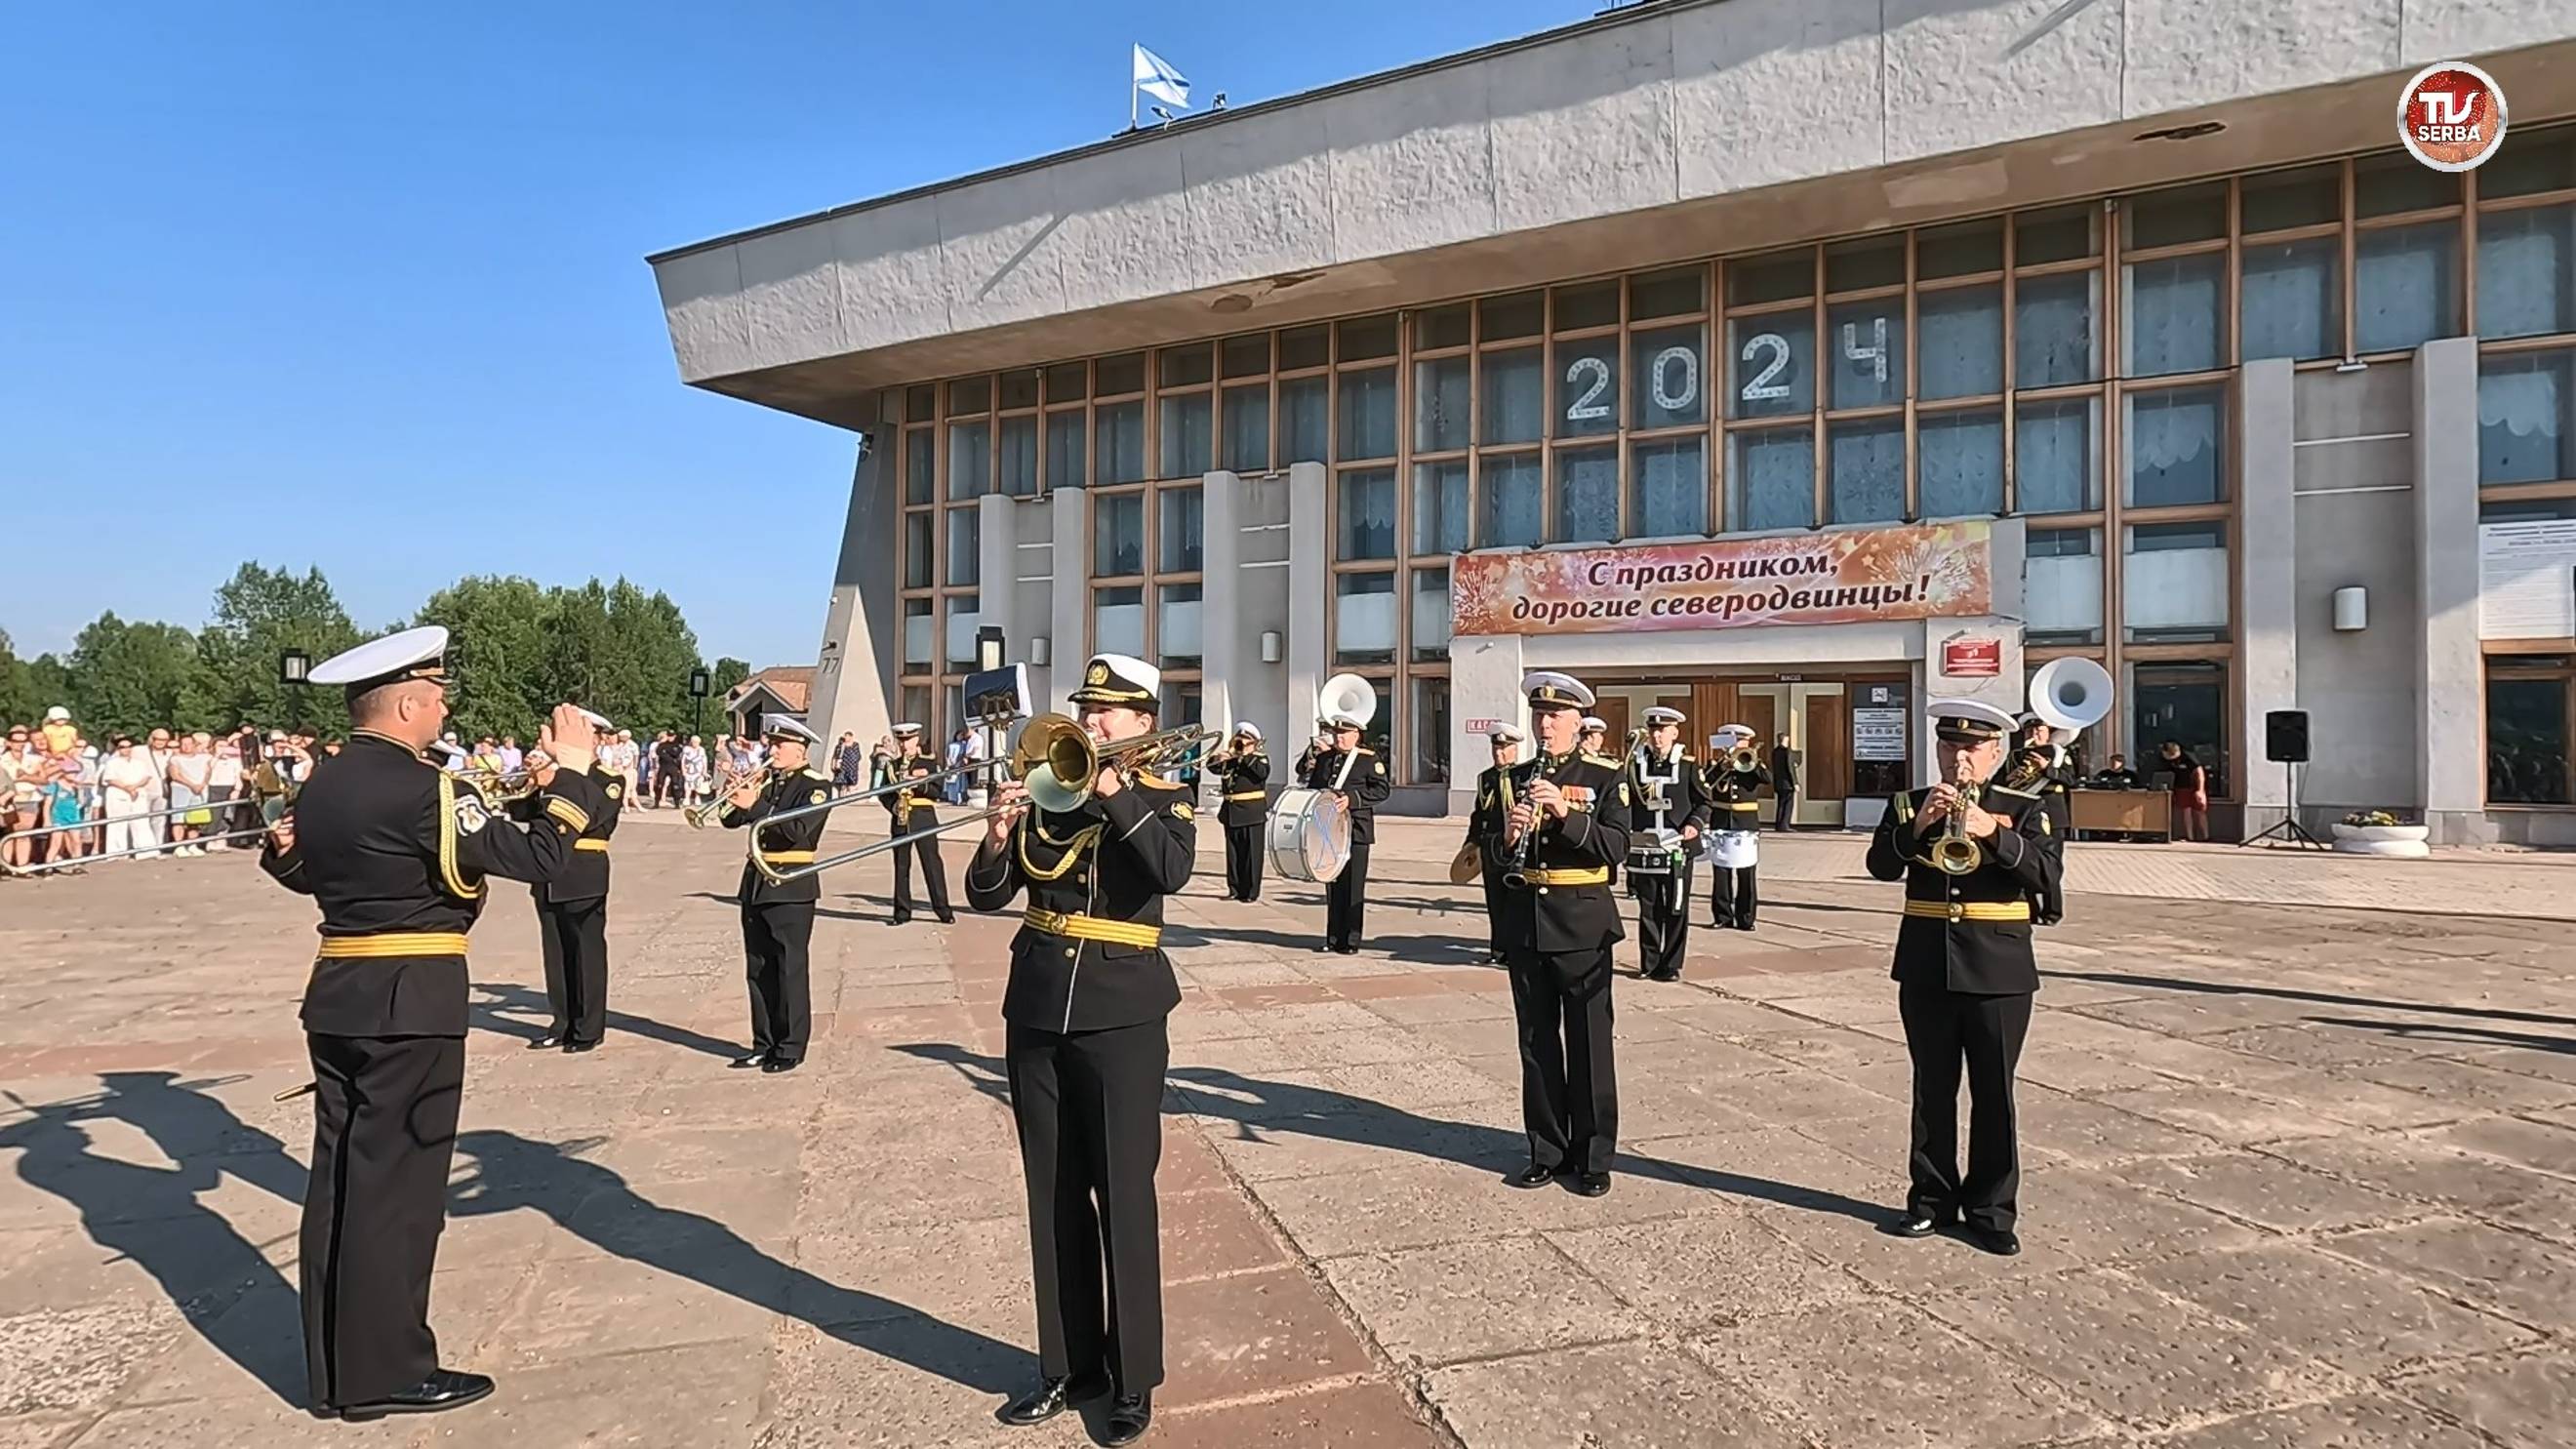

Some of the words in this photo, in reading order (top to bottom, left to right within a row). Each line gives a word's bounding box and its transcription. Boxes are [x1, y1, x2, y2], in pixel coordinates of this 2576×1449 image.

[1566, 317, 1887, 421] 2024
[1588, 562, 1609, 584] С
[1615, 555, 1838, 590] праздником,
[1512, 596, 1641, 625] дорогие
[1650, 576, 1930, 620] северодвинцы!
[823, 657, 839, 673] 77
